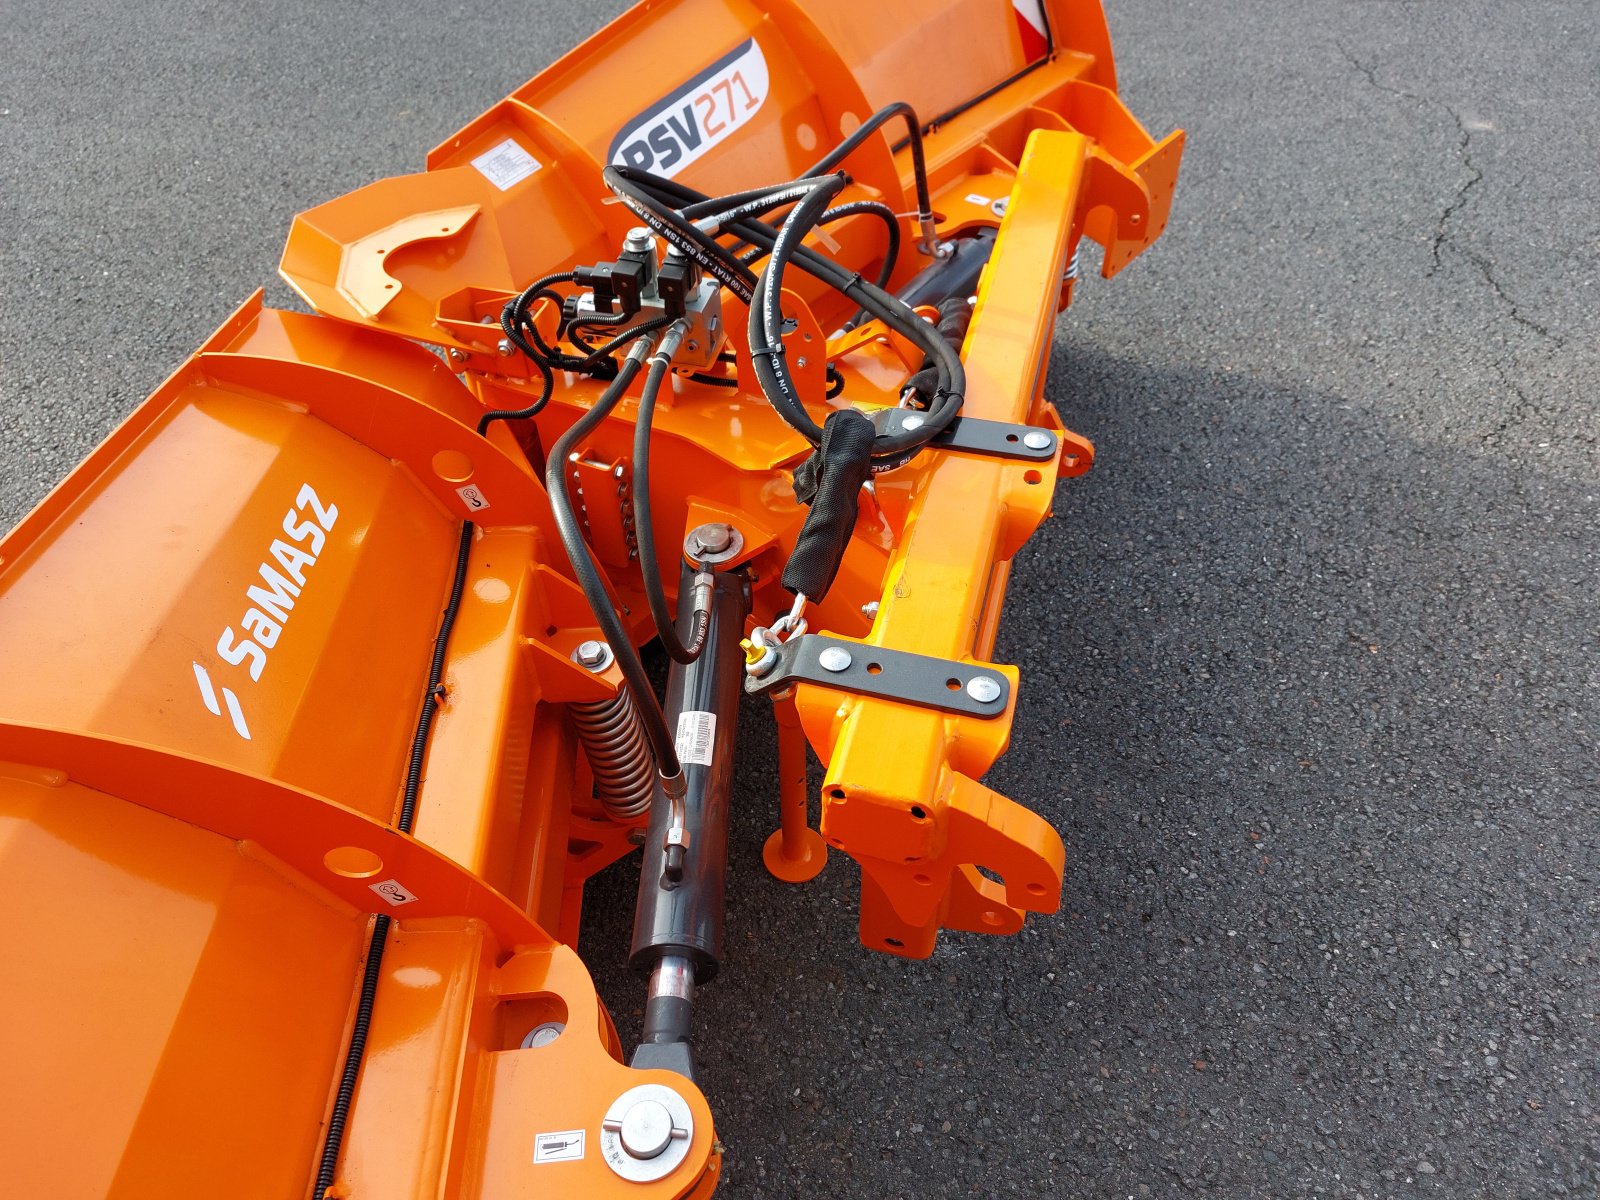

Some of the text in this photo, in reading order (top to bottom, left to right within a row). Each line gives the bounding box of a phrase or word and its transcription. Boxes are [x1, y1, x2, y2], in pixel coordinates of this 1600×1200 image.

[621, 70, 759, 172] PSV271
[649, 216, 662, 229] DN
[664, 229, 681, 246] 1SN
[681, 242, 696, 255] 853
[695, 252, 710, 265] EN
[712, 266, 732, 283] R1AT
[730, 278, 742, 290] 100
[217, 483, 338, 682] SaMASZ
